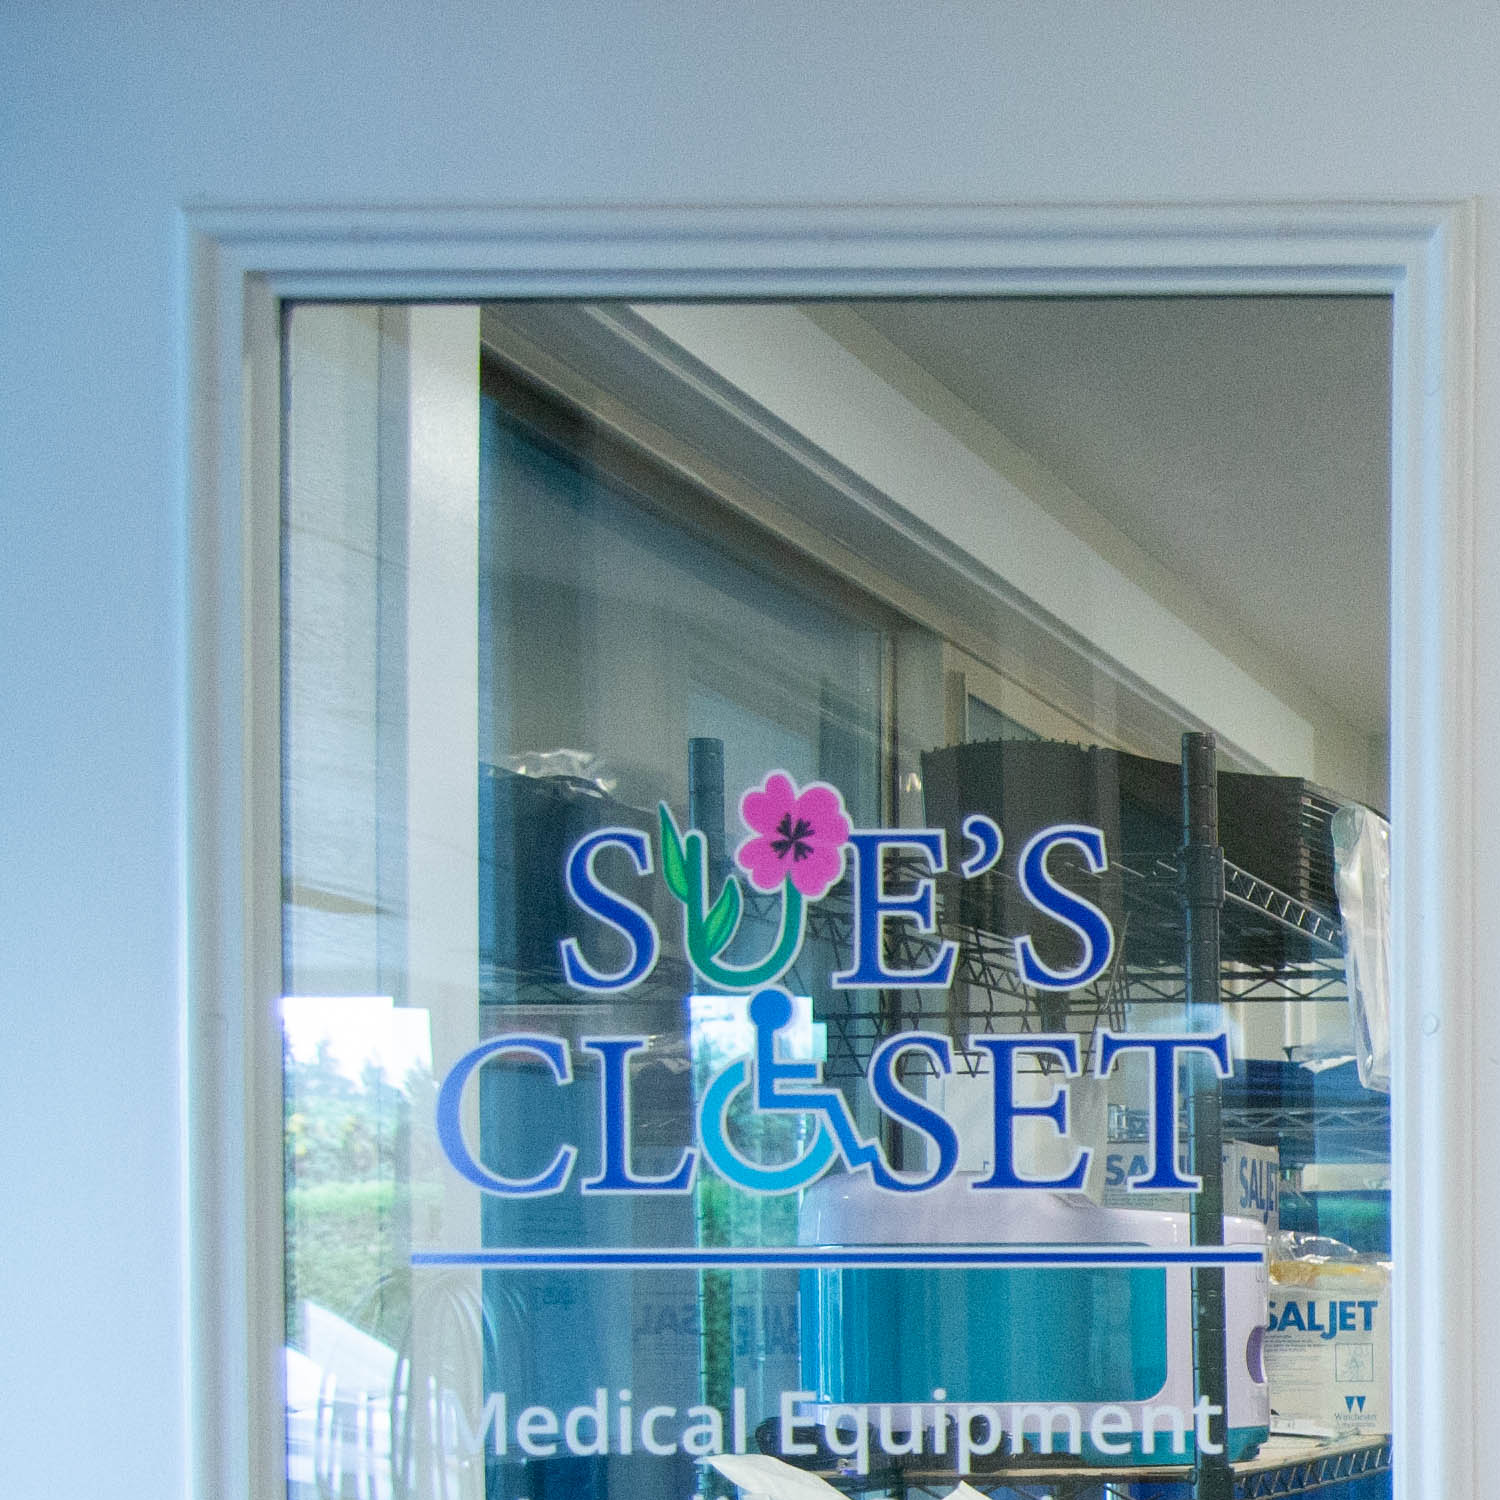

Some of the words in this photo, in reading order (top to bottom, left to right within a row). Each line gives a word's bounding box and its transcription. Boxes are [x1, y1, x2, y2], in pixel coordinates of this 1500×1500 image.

[559, 785, 1115, 996] SUE'S
[436, 1020, 1233, 1196] CLOSET
[441, 1387, 747, 1457] Medical
[781, 1388, 1223, 1476] Equipment
